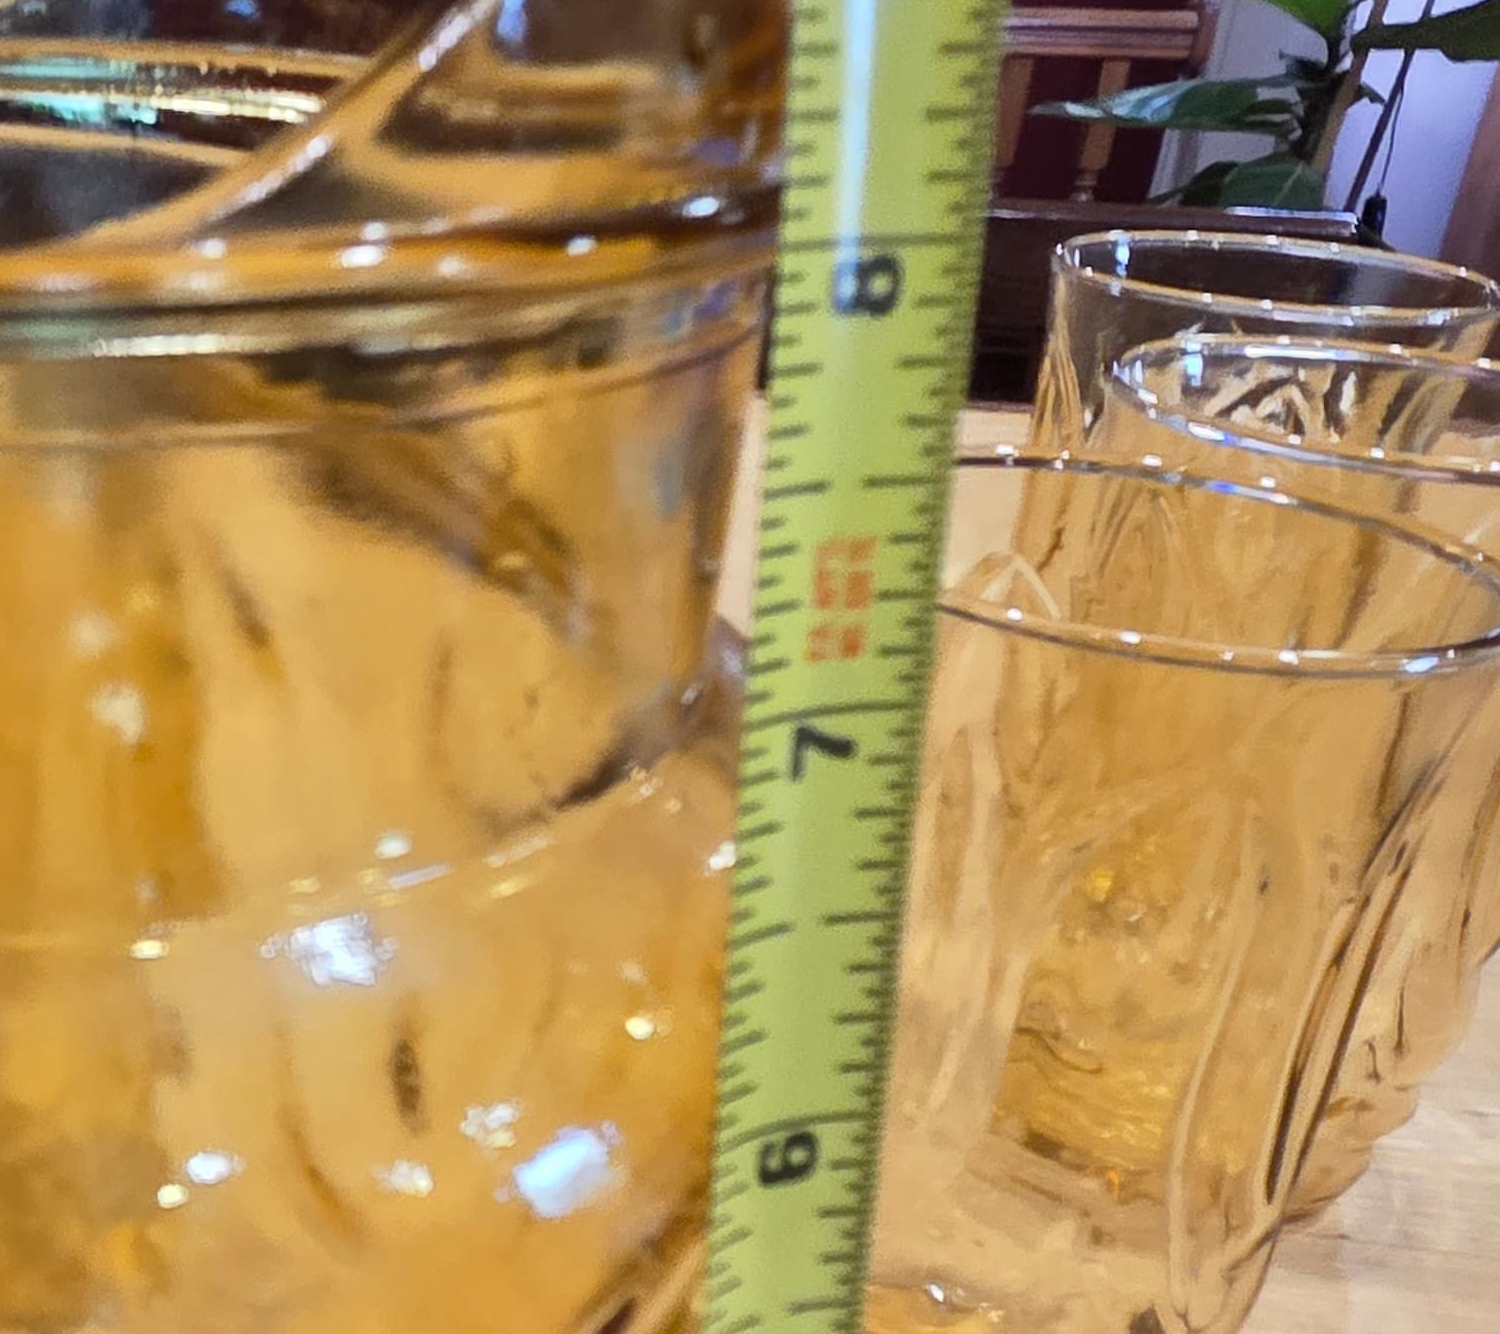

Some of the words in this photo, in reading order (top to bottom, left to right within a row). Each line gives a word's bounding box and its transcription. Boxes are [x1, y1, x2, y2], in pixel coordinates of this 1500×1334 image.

[831, 253, 904, 315] 8
[788, 724, 855, 782] 7
[757, 1131, 818, 1188] 6
